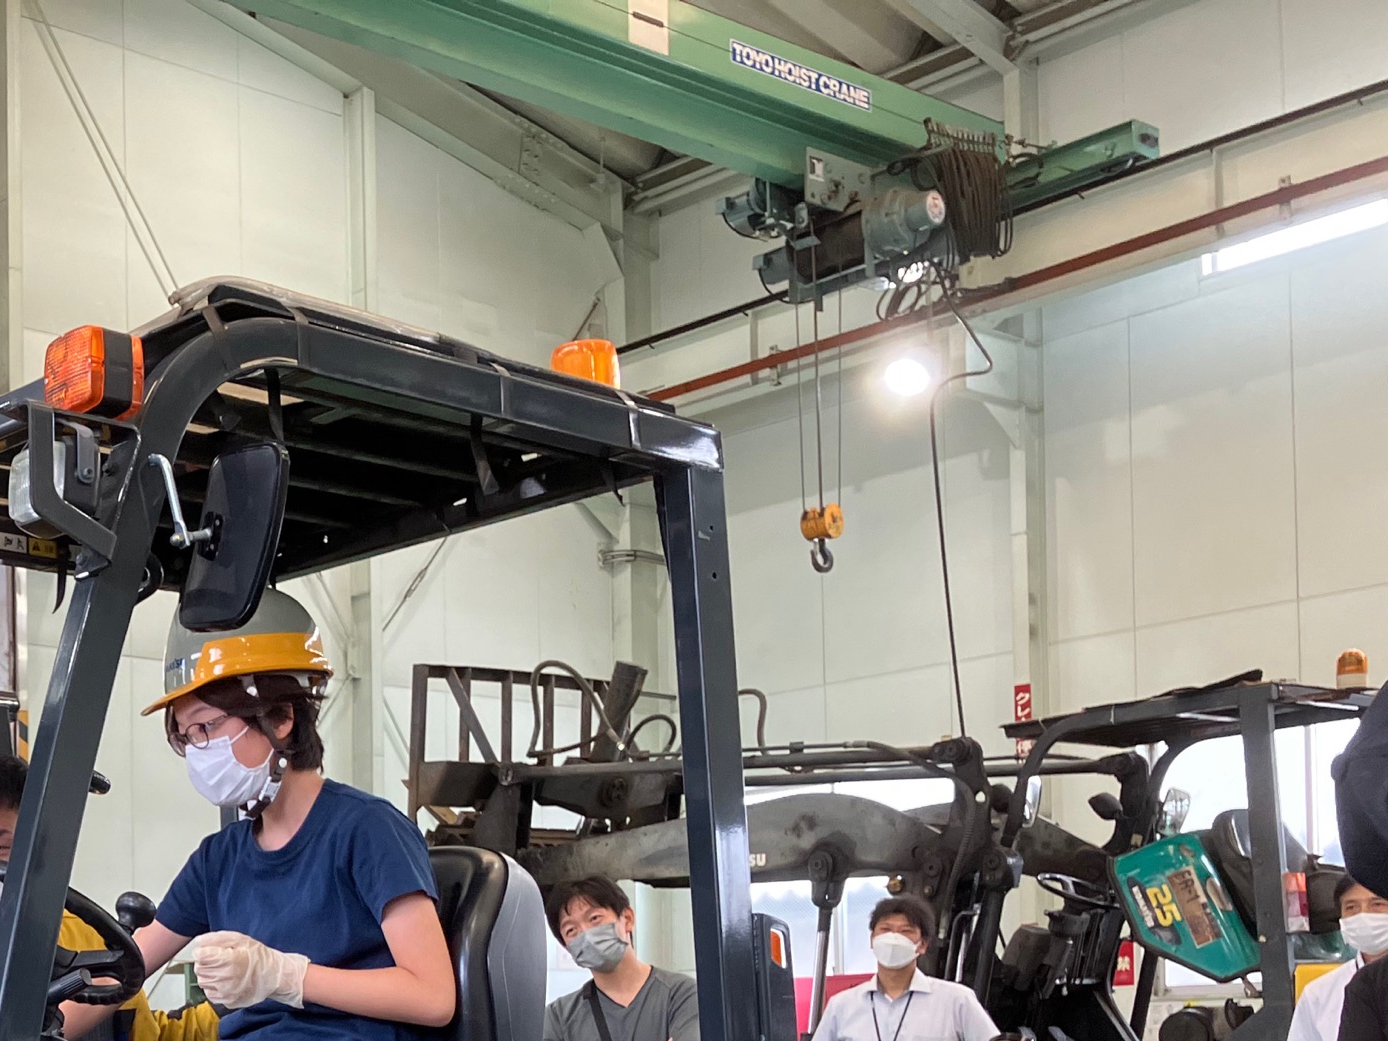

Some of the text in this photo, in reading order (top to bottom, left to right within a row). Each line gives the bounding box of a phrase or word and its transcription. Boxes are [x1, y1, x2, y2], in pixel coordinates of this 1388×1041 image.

[733, 43, 869, 109] TOYO HOIST CRANE
[1146, 884, 1182, 927] 25
